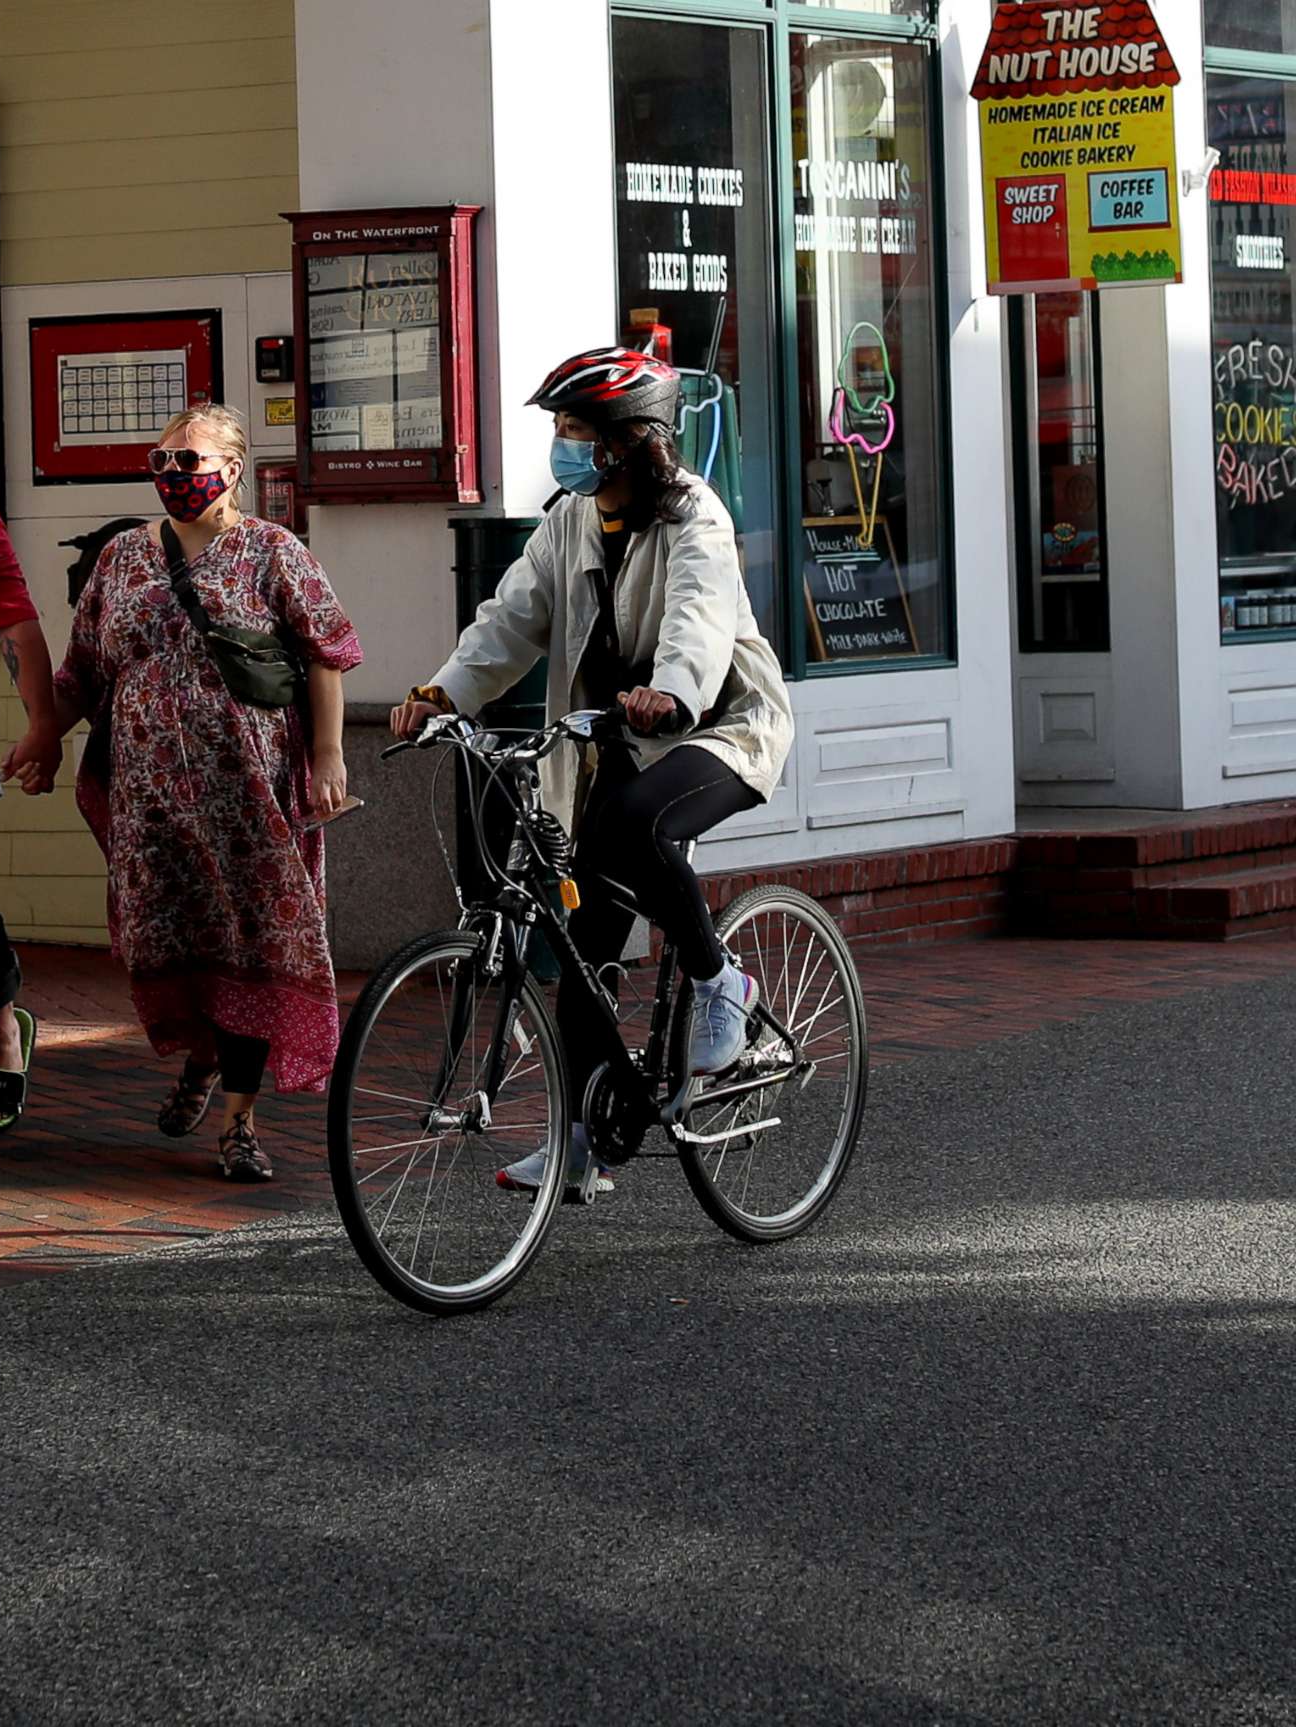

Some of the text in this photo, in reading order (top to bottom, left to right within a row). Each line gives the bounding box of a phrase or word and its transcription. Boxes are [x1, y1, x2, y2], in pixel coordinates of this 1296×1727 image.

[1042, 7, 1102, 42] THE
[988, 42, 1158, 84] NUT HOUSE
[988, 95, 1166, 124] HOMEMADE ICE CREAM
[1032, 122, 1122, 144] ITALIAN ICE
[1020, 145, 1136, 169] COOKIE BAKERY
[626, 162, 744, 207] HOMEMADE COOKIES
[798, 158, 911, 200] TOSCANINI'S
[1100, 178, 1155, 198] COFFEE
[1004, 184, 1059, 205] SWEET
[1012, 205, 1055, 224] SHOP
[1113, 202, 1144, 220] BAR
[312, 226, 440, 240] ON THE WATERFRONT
[682, 209, 692, 247] &
[795, 214, 916, 254] HOMADE ICE CREAM
[648, 252, 728, 292] BAKED GOODS
[265, 484, 289, 497] FIRE
[824, 565, 858, 593] HOT
[816, 598, 887, 622] CHOCOLATE
